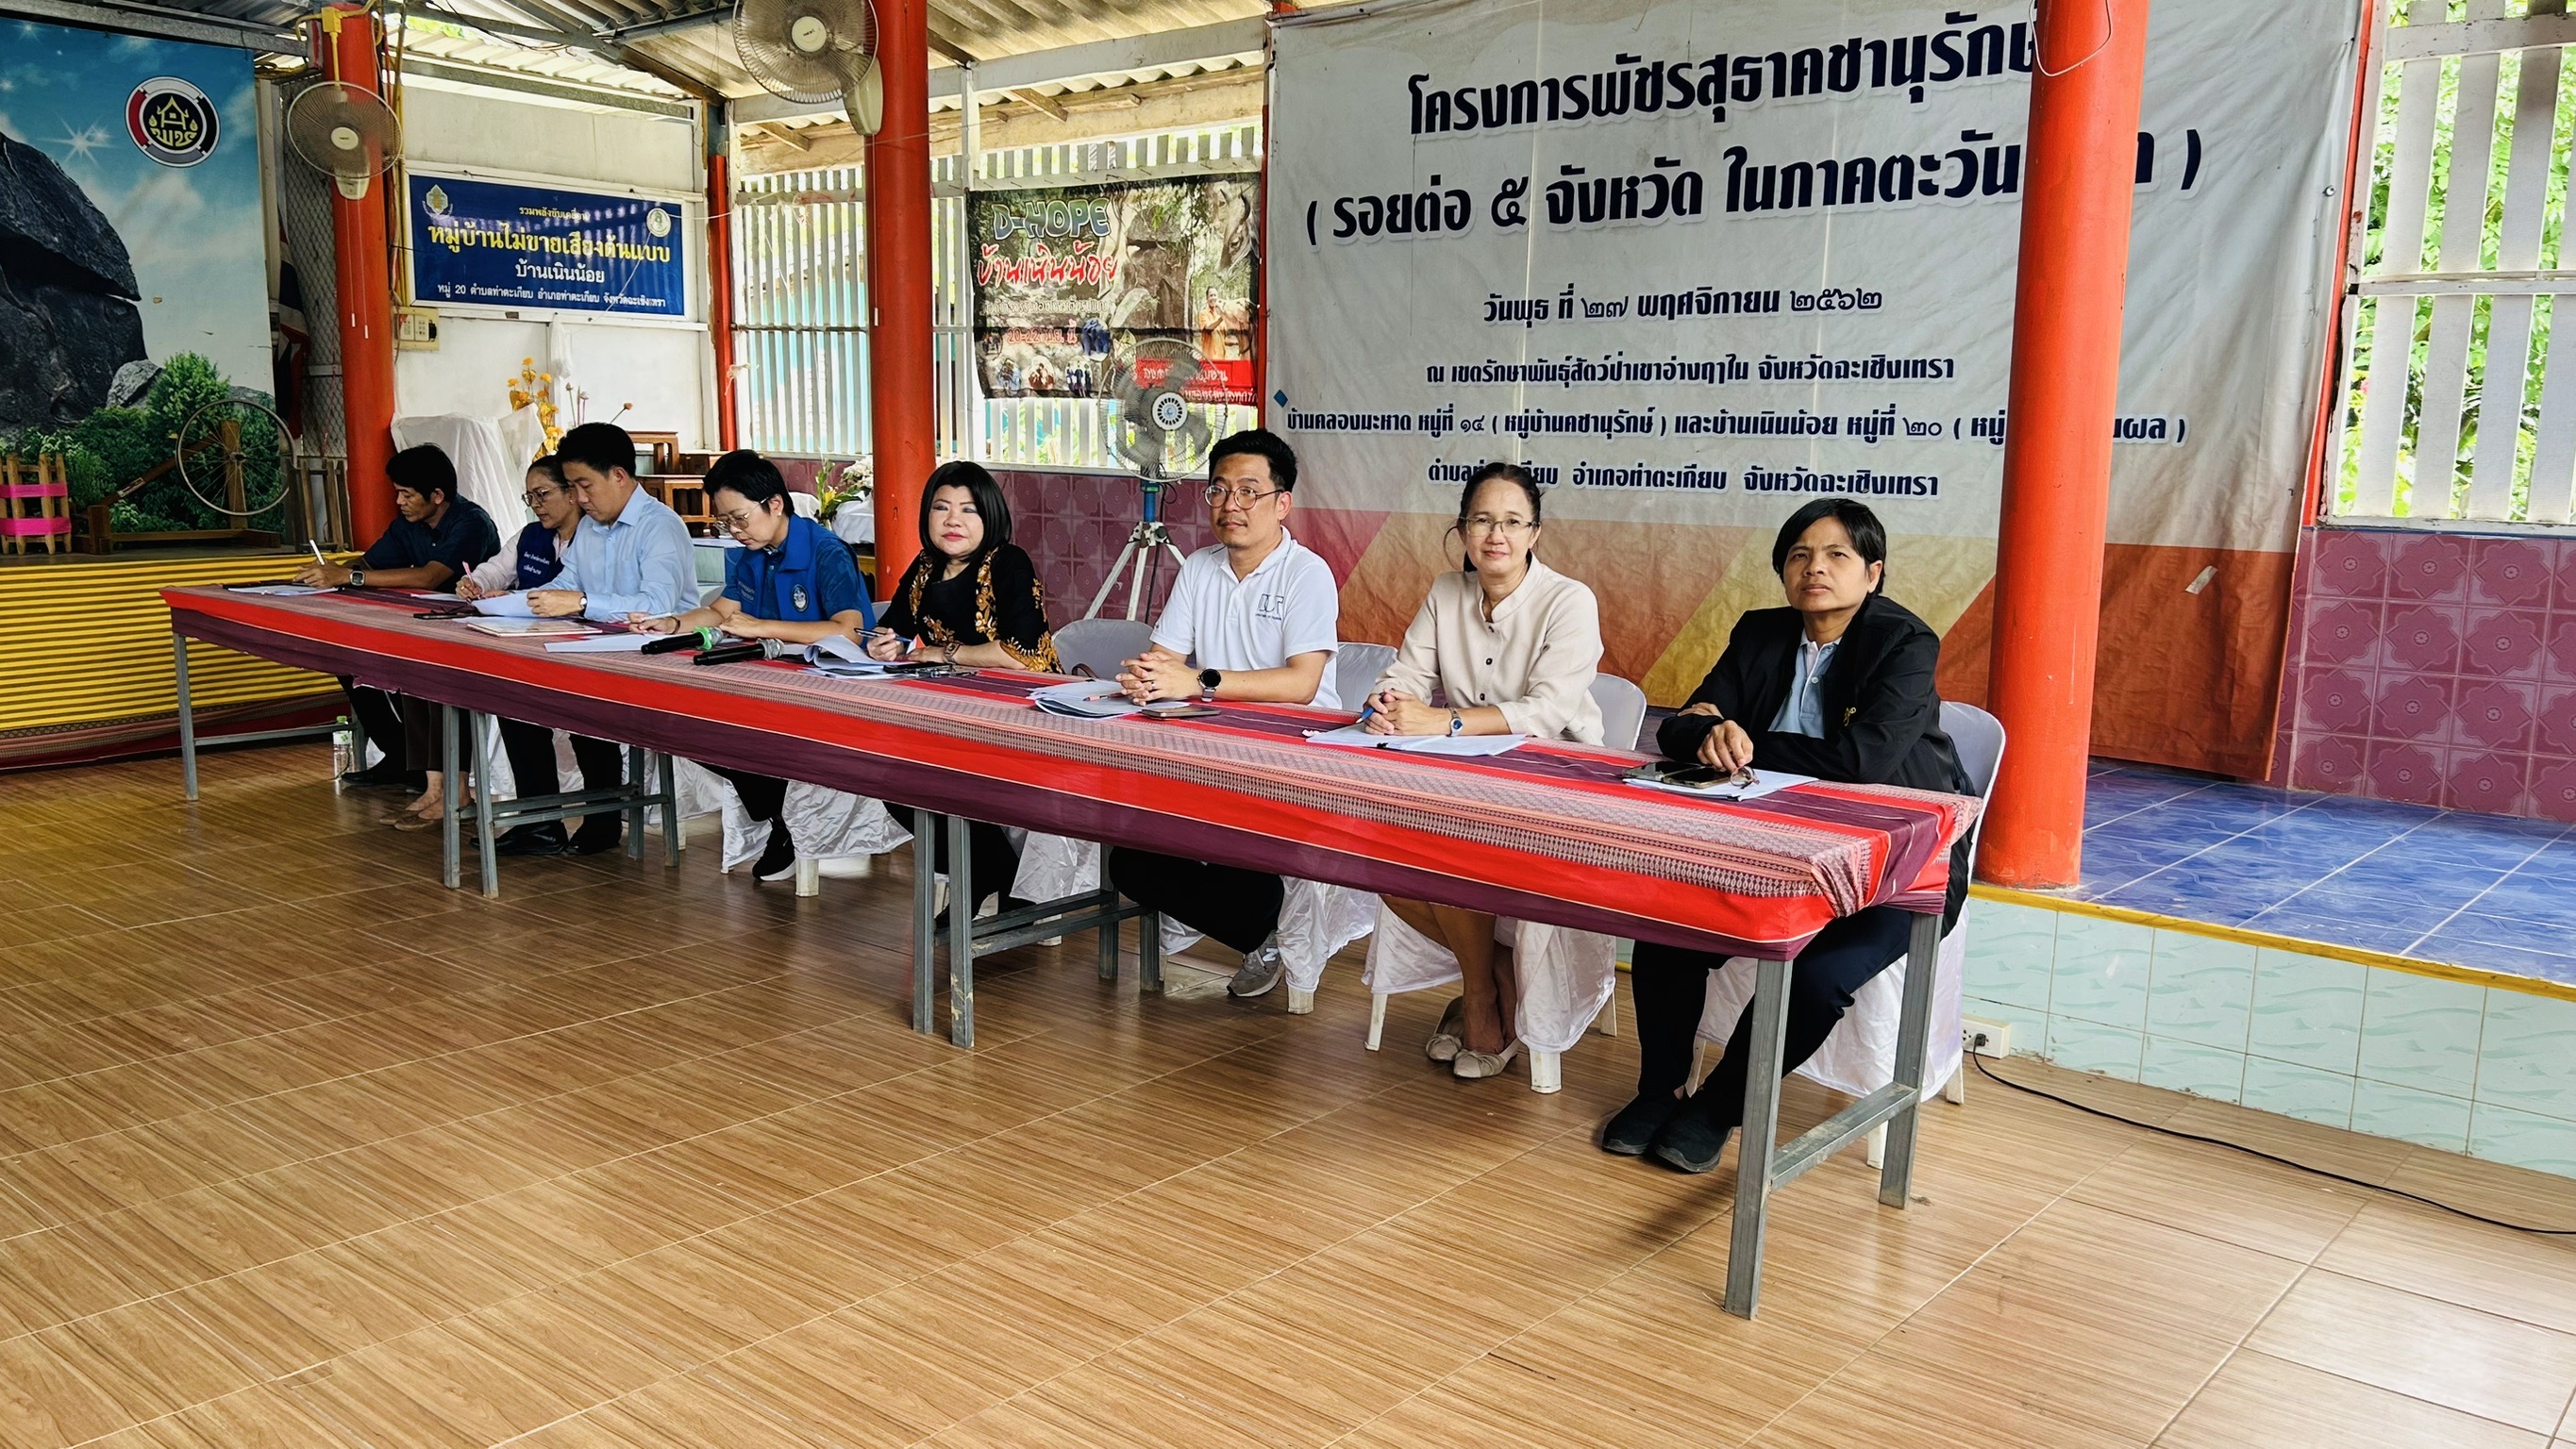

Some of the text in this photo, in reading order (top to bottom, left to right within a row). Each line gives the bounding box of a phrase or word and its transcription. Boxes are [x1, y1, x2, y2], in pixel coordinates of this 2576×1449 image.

[1408, 9, 2036, 134] โครงการพัชรสุธาคชานุรักษ
[991, 197, 1112, 241] D-HOPE
[1332, 174, 1472, 239] รอยต่อ
[1491, 175, 1530, 227] ๕
[1546, 156, 1703, 225] จังหวัด
[427, 220, 672, 263] หมู่บ้านไม่ขายเสียงต้นแบบ
[515, 258, 606, 283] บ้านเนินน้อย
[978, 239, 1119, 288] บ้านเนินน้อย
[438, 281, 666, 308] หมู่ 20 ตำบลท่าตะเกียบ อำเภอท่าตะเกียบ จังหวัดฉะเชิงเทรา
[1483, 282, 1882, 328] วันพุธ ที่ ๒๗ พฤศจิกายน ๒๕๖๒
[1426, 365, 1445, 383] ณ
[1758, 353, 1954, 380] จังหวัดฉะเชิงเทรา
[1287, 407, 1412, 431] บ้านคลองมะหาด
[1418, 403, 1454, 439] หมู่ที่
[1460, 414, 1485, 433] ๑๔
[1504, 407, 1656, 440] หมู่บ้านคชานุรักษ์
[1674, 408, 1838, 435] และบ้านเนินน้อย
[1847, 403, 1897, 444] หมู่ที่
[1902, 417, 1943, 437] ๒๐
[1572, 460, 1727, 488] อำเภอท่าตะเกียบ
[1743, 465, 1938, 496] จังหวัดฉะเชิงเทรา
